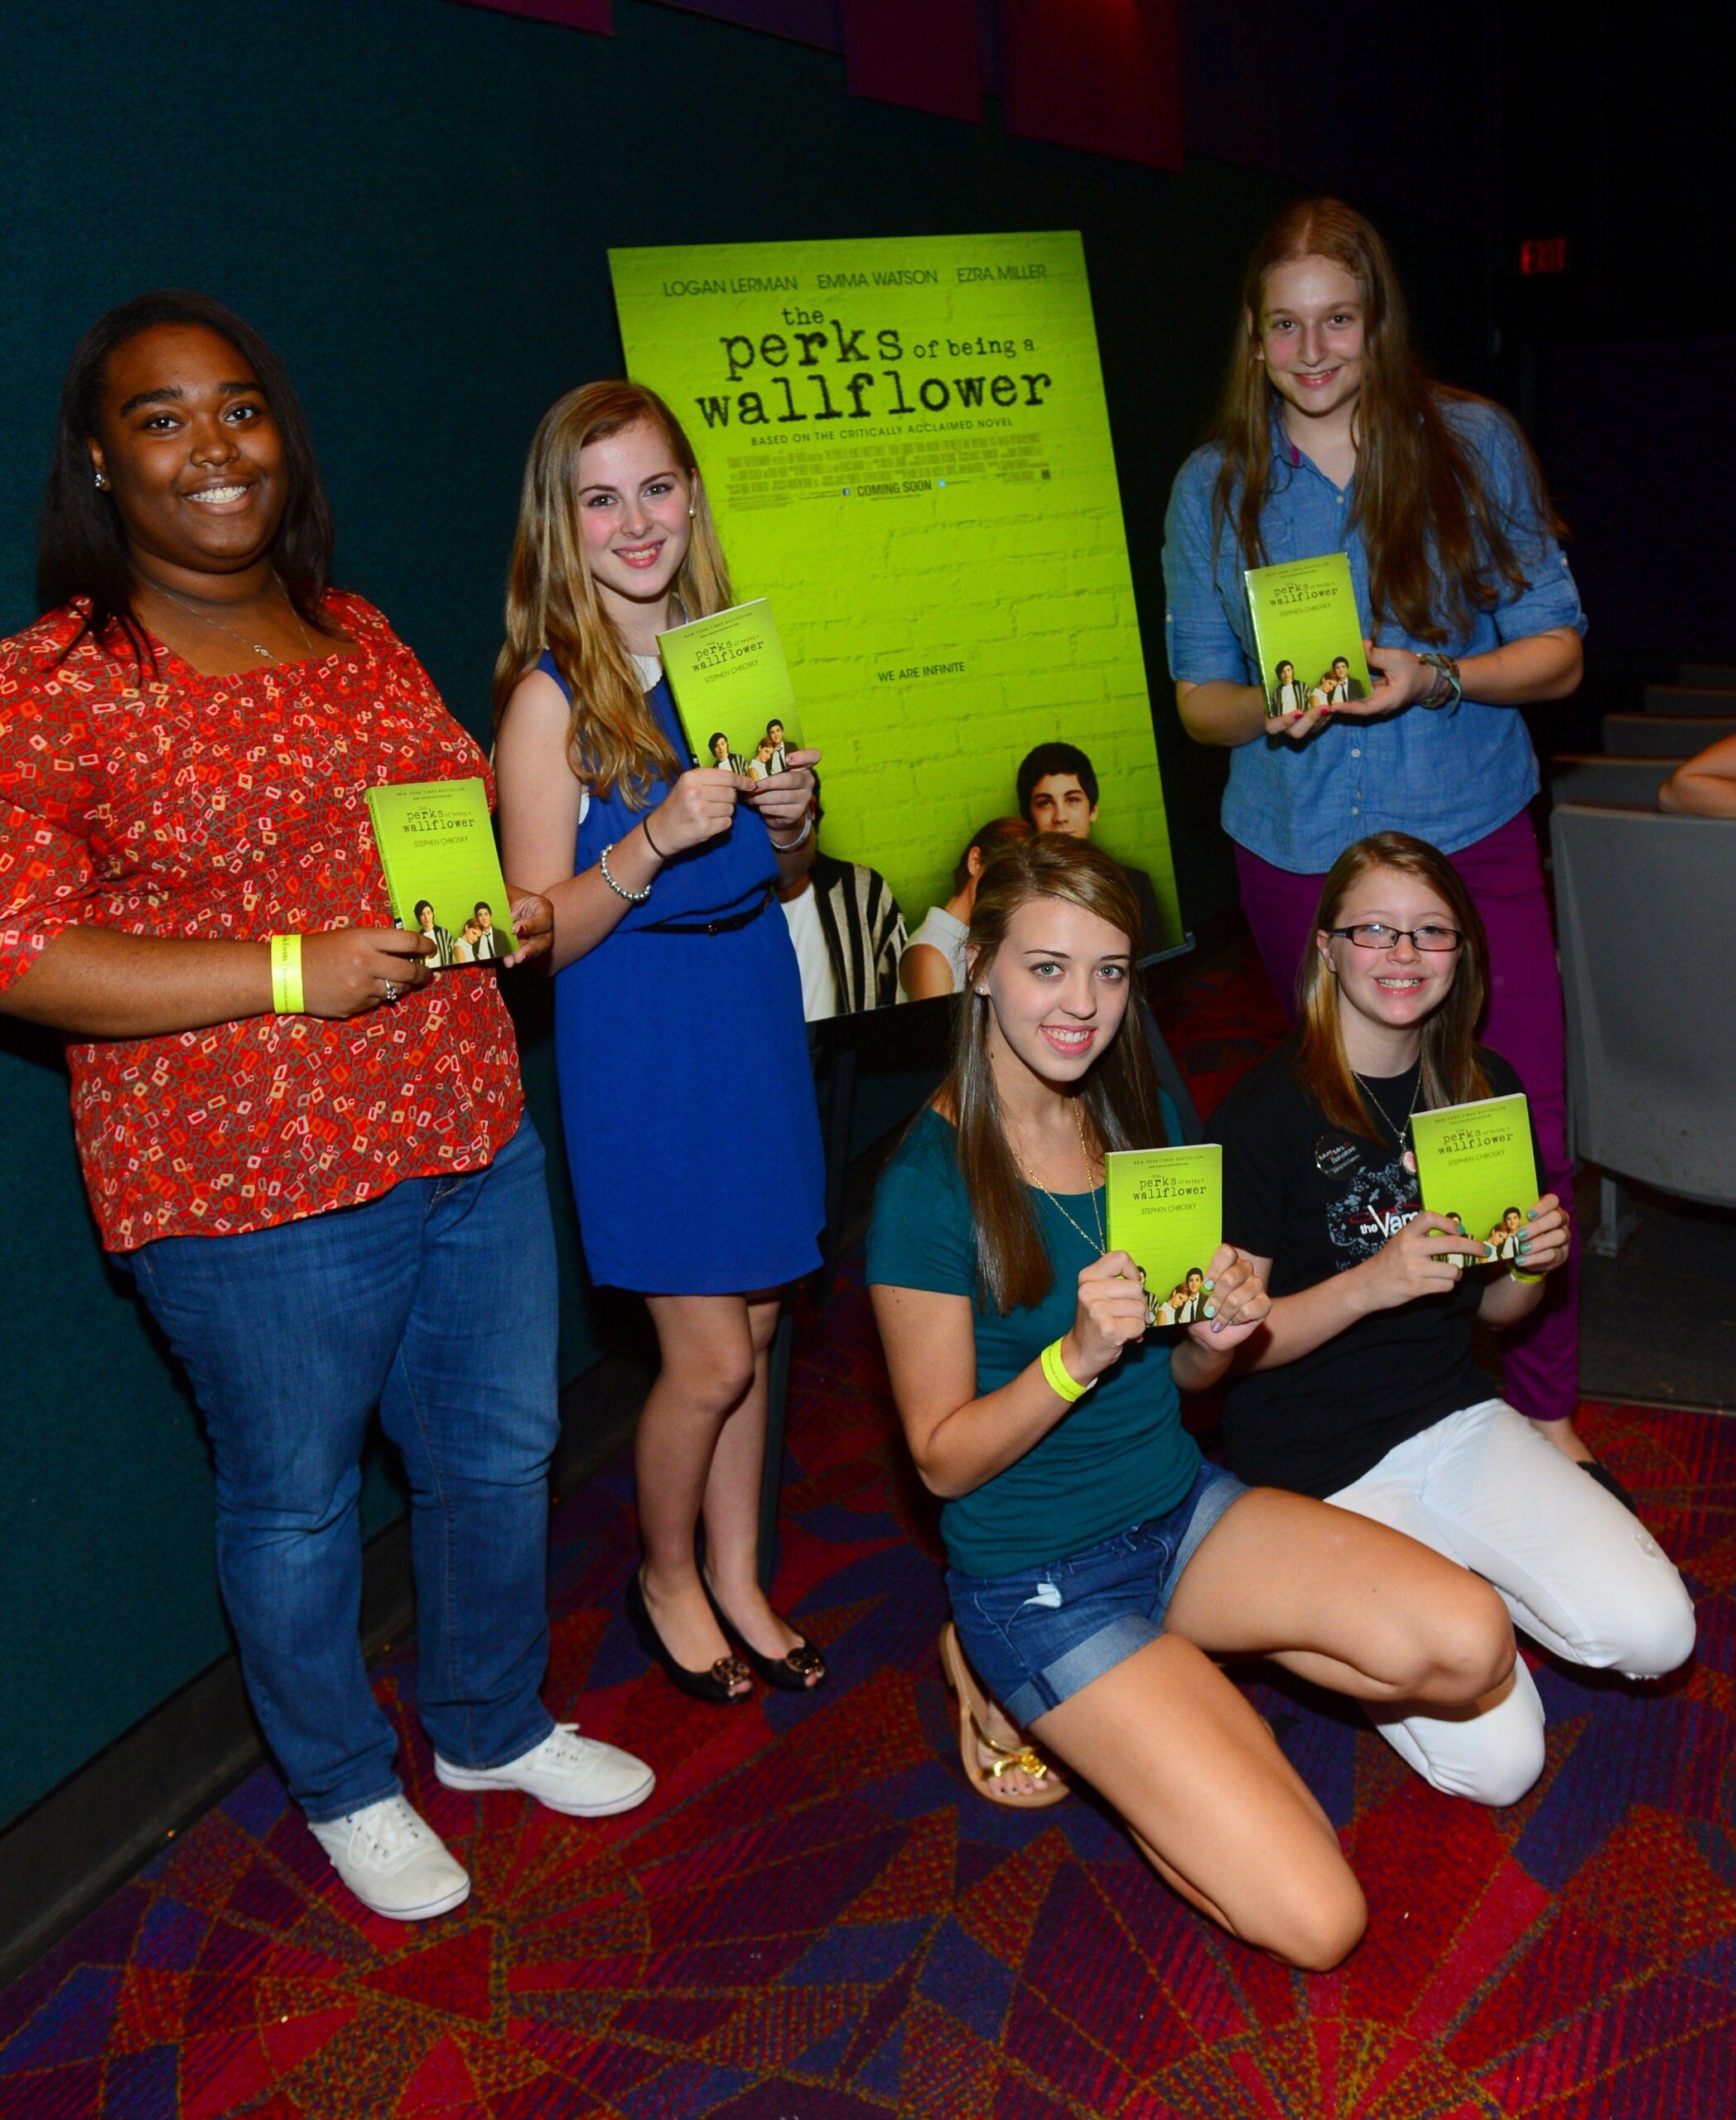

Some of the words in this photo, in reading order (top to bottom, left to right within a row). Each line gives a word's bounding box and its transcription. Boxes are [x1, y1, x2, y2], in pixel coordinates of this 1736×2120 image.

[817, 272, 869, 289] EMMA
[871, 269, 938, 286] WATSON
[957, 267, 994, 282] EZRA
[997, 264, 1047, 279] MILLER
[663, 278, 726, 296] LOGAN
[730, 276, 798, 293] LERMAN
[781, 306, 824, 325] the
[719, 320, 903, 381] perks
[914, 340, 939, 359] of
[946, 336, 1017, 359] being
[1023, 338, 1035, 351] a
[695, 369, 1053, 428] wallflower
[750, 434, 788, 446] BASED
[793, 432, 811, 443] ON
[815, 431, 835, 441] THE
[839, 425, 903, 440] CRITICALLY
[908, 420, 973, 434] ACCLAIMED
[976, 417, 1013, 428] NOVEL
[856, 482, 900, 497] COMING
[902, 479, 933, 494] SOON
[1270, 587, 1338, 606] wallflower
[1274, 582, 1309, 597] perks
[692, 640, 764, 672] wallflower
[695, 640, 733, 662] perks
[704, 670, 731, 684] STEPHEN
[731, 659, 759, 674] CHBOSKY
[878, 670, 895, 682] WE
[899, 667, 919, 679] ARE
[923, 662, 966, 676] INFINITE
[406, 808, 444, 822] perks
[403, 818, 475, 832] wallflower
[414, 838, 439, 847] STEPHEN
[1438, 1133, 1514, 1155] wallflower
[1444, 1129, 1482, 1145] perks
[1140, 1176, 1177, 1191] perks
[1133, 1186, 1207, 1201] wallflower
[1141, 1205, 1167, 1215] STEPHEN
[1168, 1203, 1197, 1212] CHBOSKY
[1359, 1223, 1378, 1235] the
[1367, 1204, 1420, 1238] Vam
